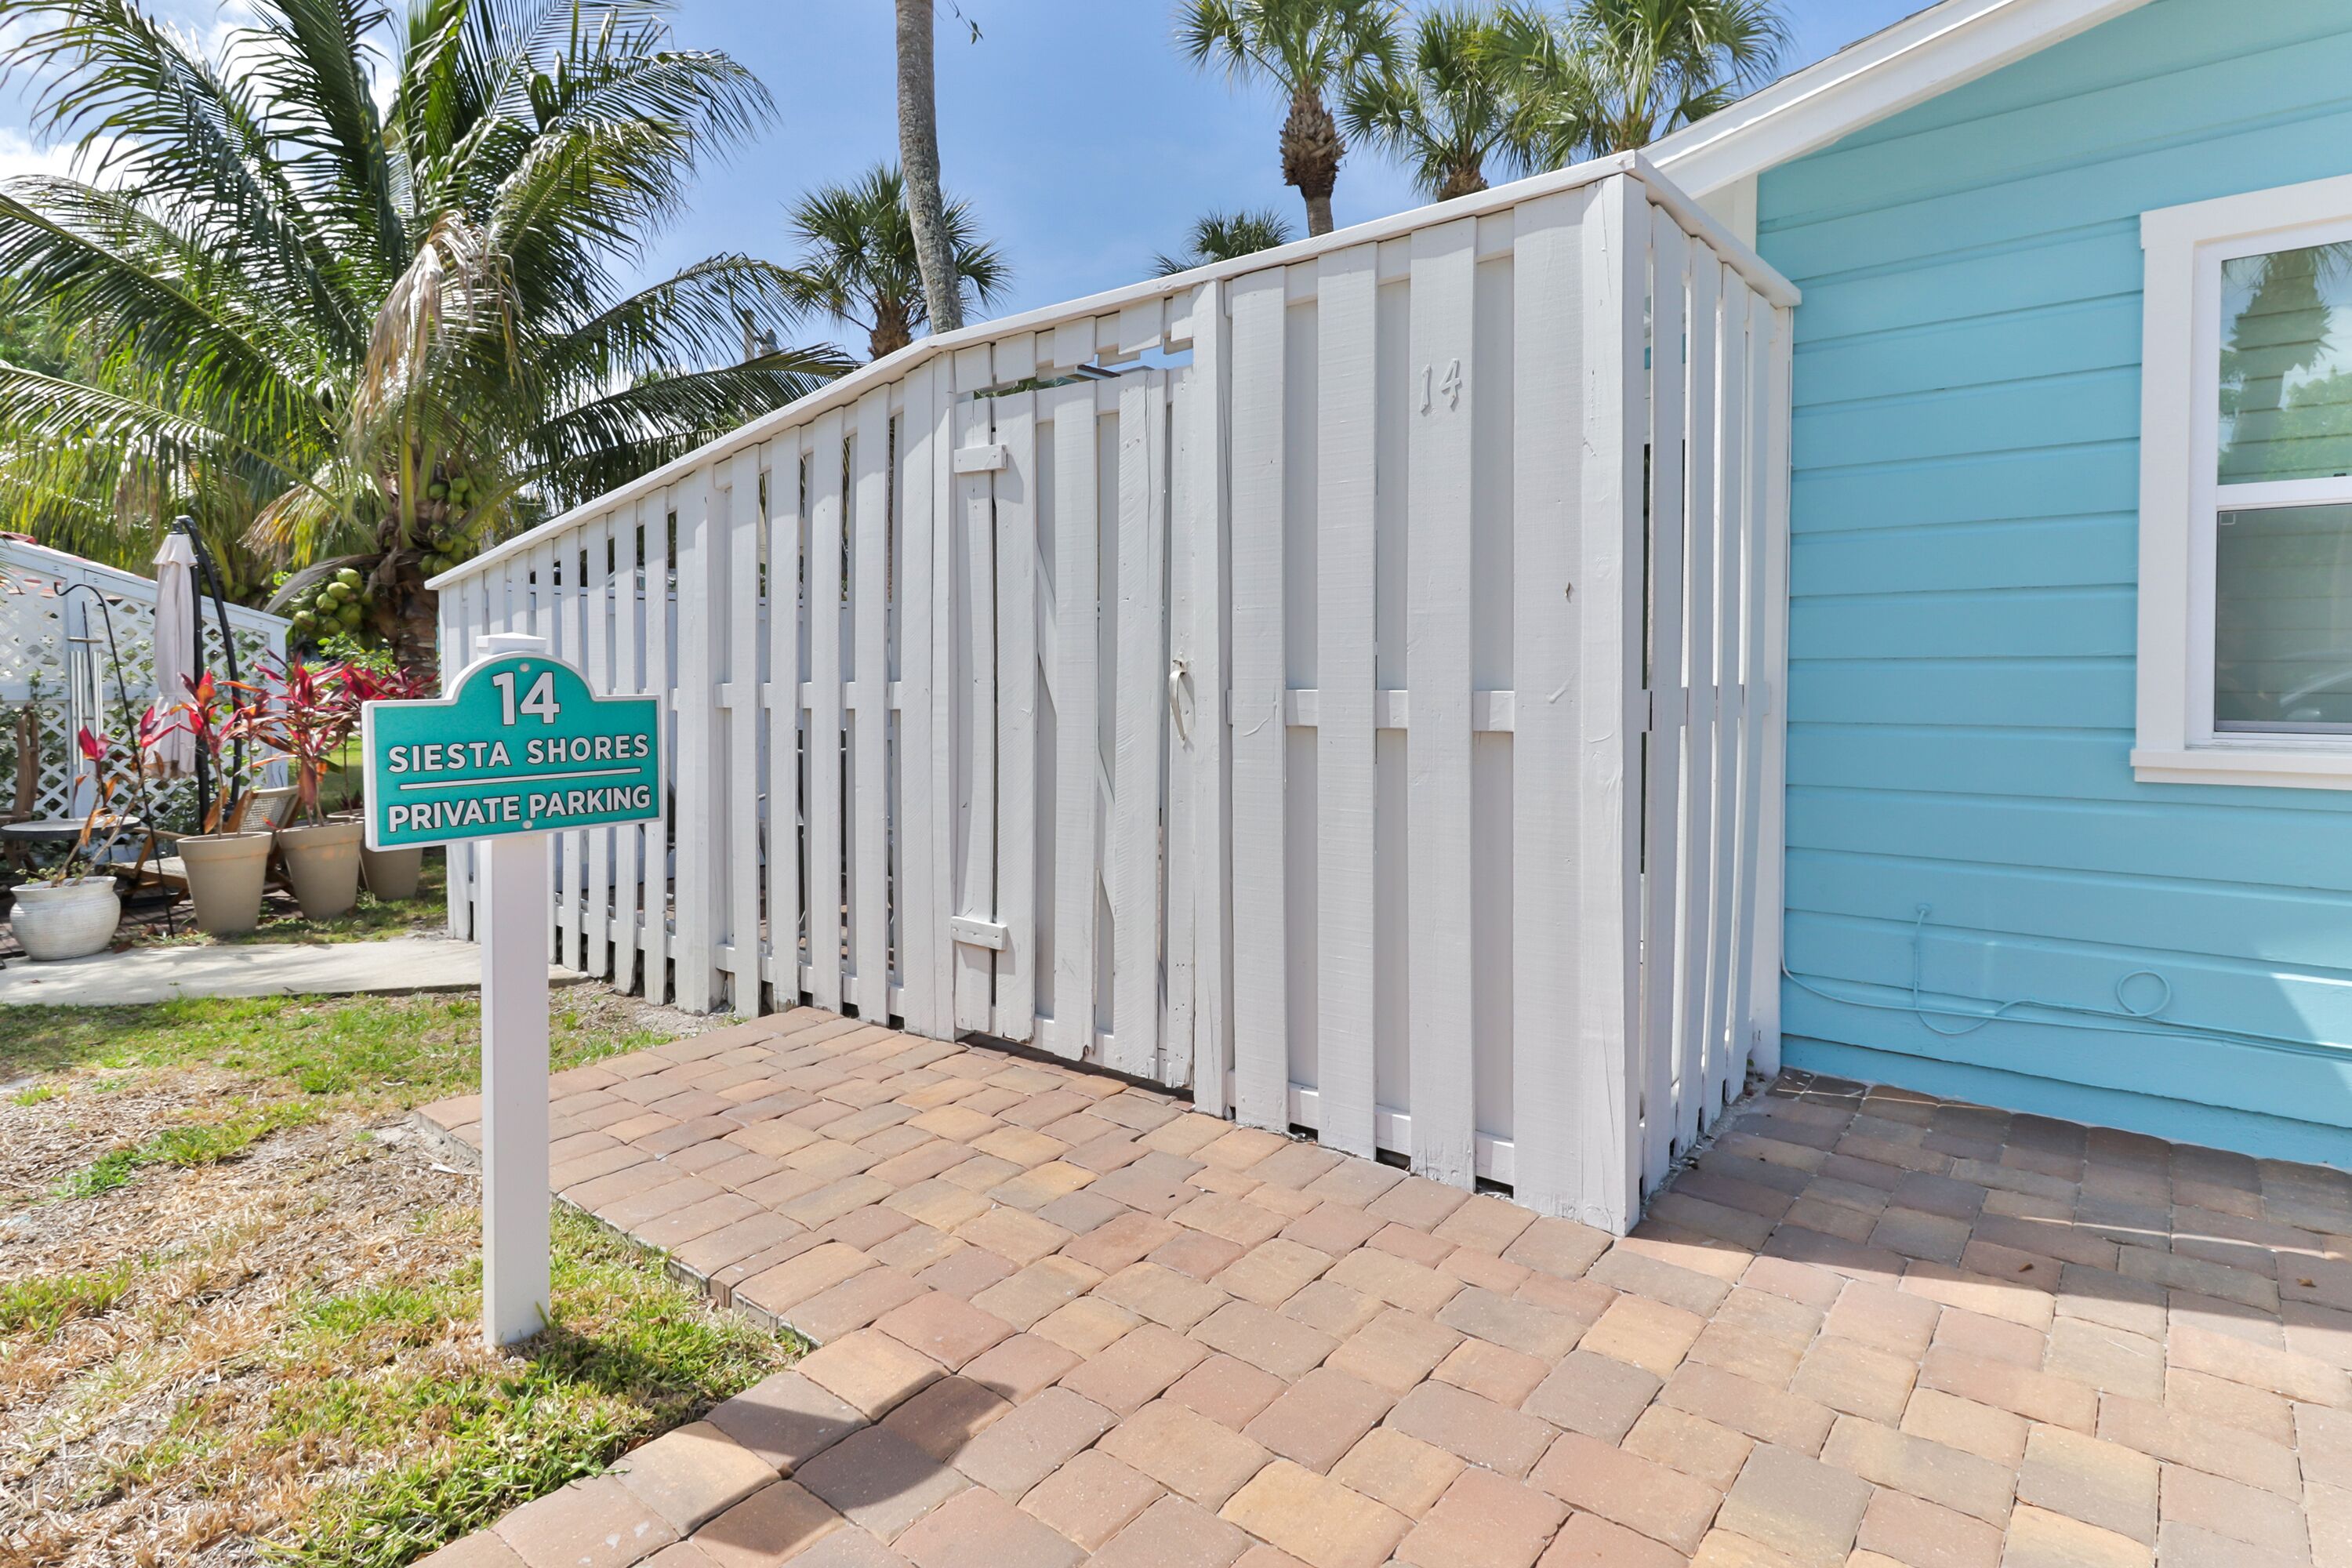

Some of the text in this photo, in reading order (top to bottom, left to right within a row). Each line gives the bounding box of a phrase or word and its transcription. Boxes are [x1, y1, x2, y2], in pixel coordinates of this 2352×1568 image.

[1420, 358, 1462, 416] 14
[492, 672, 561, 726] 14
[388, 734, 649, 773] SIESTA SHORES
[388, 785, 651, 833] PRIVATE PARKING
